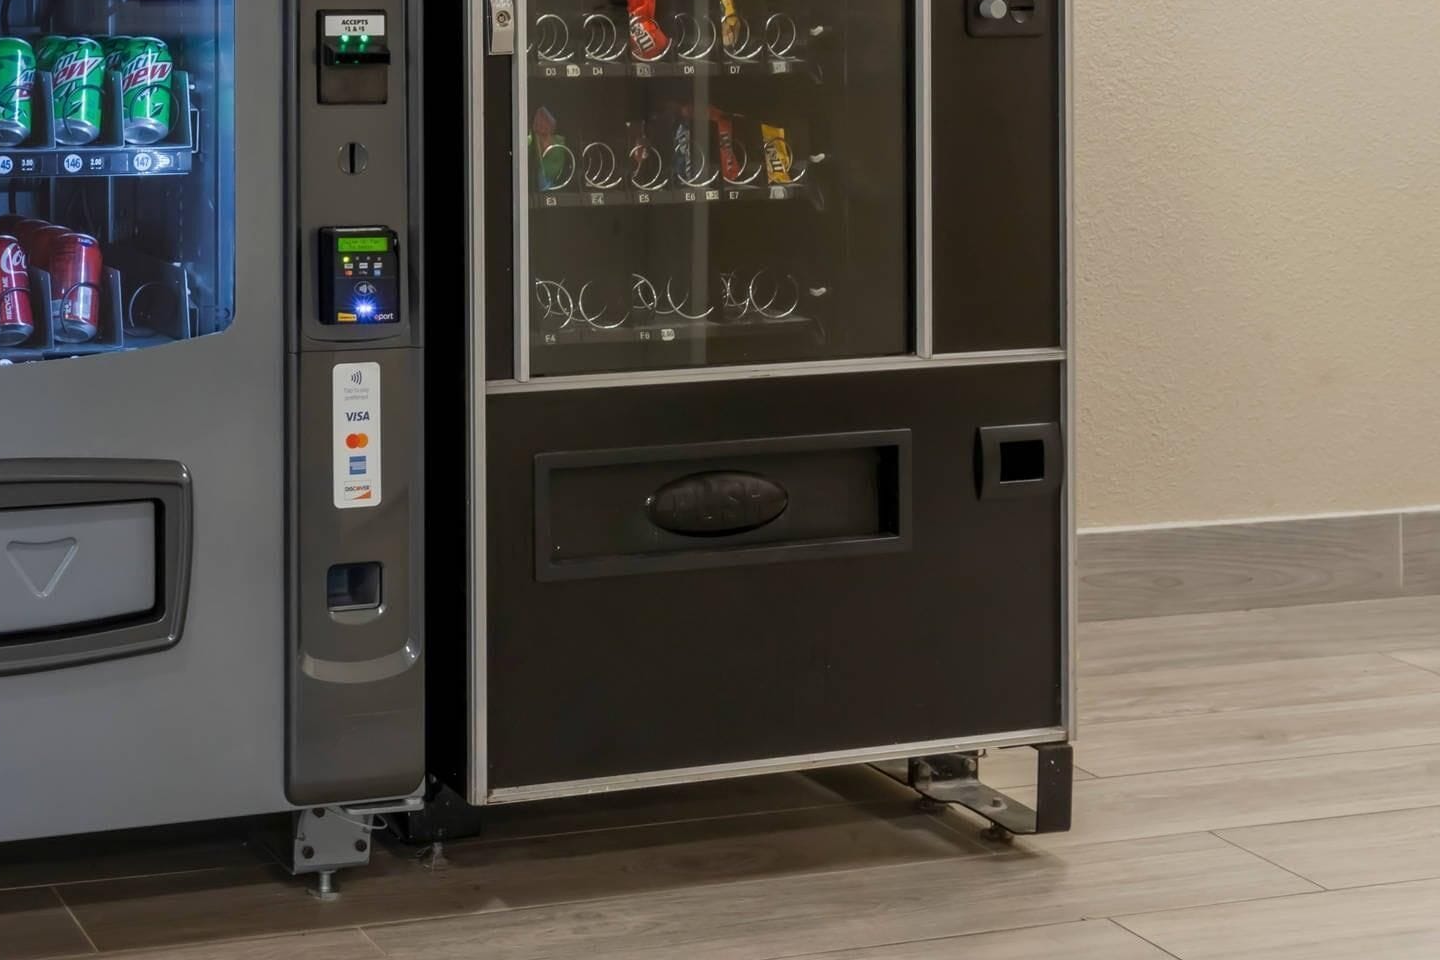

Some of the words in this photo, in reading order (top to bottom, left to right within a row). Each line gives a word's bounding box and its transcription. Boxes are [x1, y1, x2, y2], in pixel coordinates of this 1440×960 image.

[65, 158, 81, 169] 146
[136, 157, 150, 167] 147
[345, 411, 370, 421] VISA
